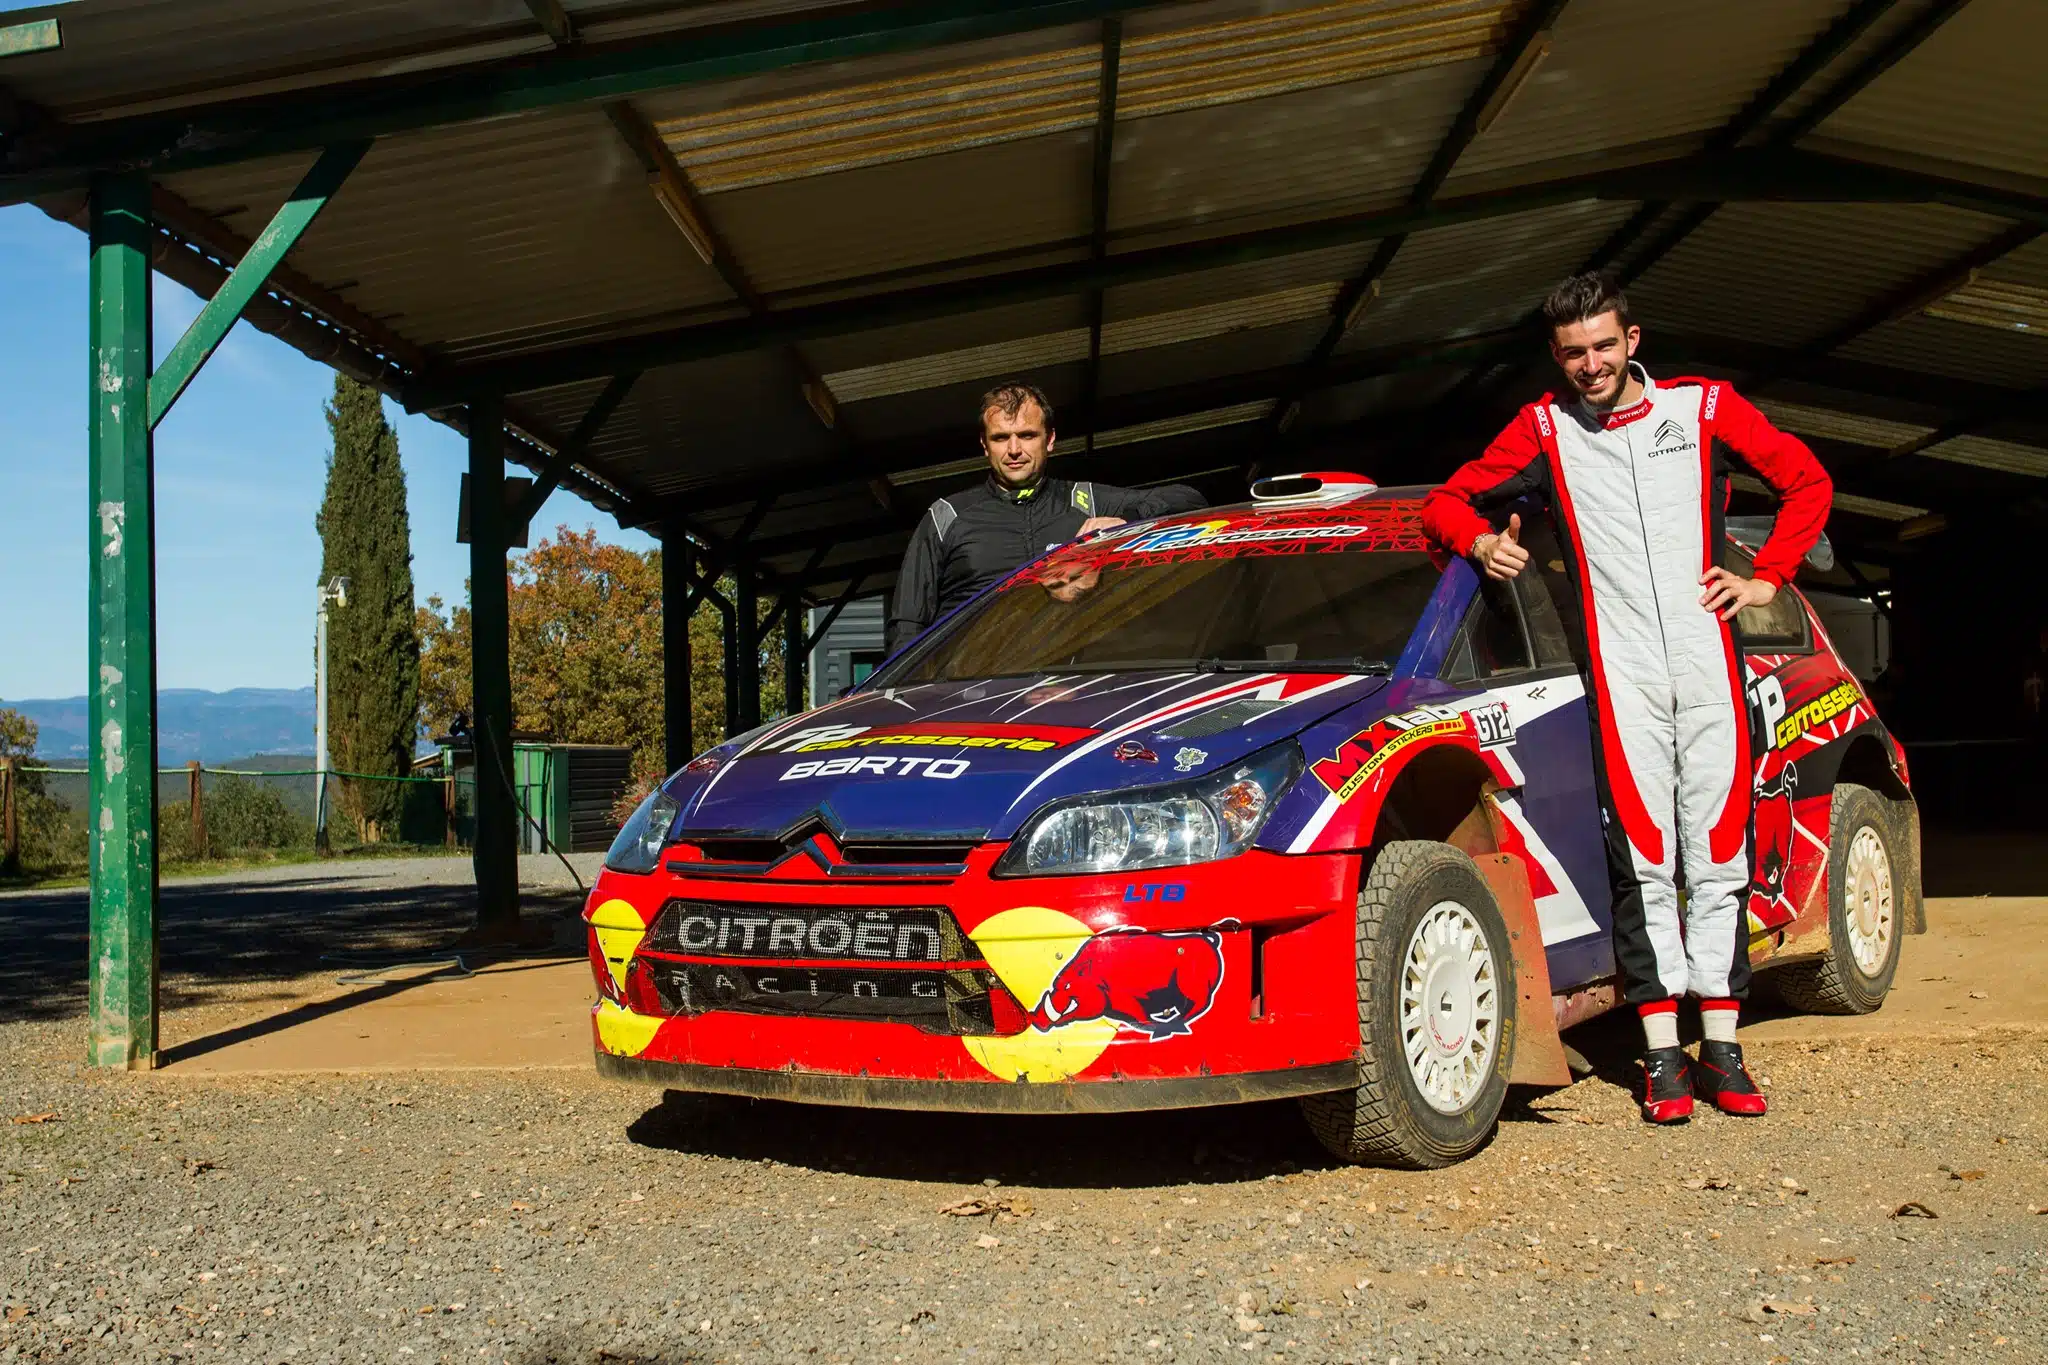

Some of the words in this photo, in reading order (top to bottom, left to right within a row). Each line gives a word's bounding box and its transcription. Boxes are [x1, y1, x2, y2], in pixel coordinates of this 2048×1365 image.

[796, 734, 1056, 752] carrosserie
[1340, 752, 1386, 799] CUSTOM
[1387, 725, 1433, 751] STICKERS
[1123, 884, 1187, 902] LTB
